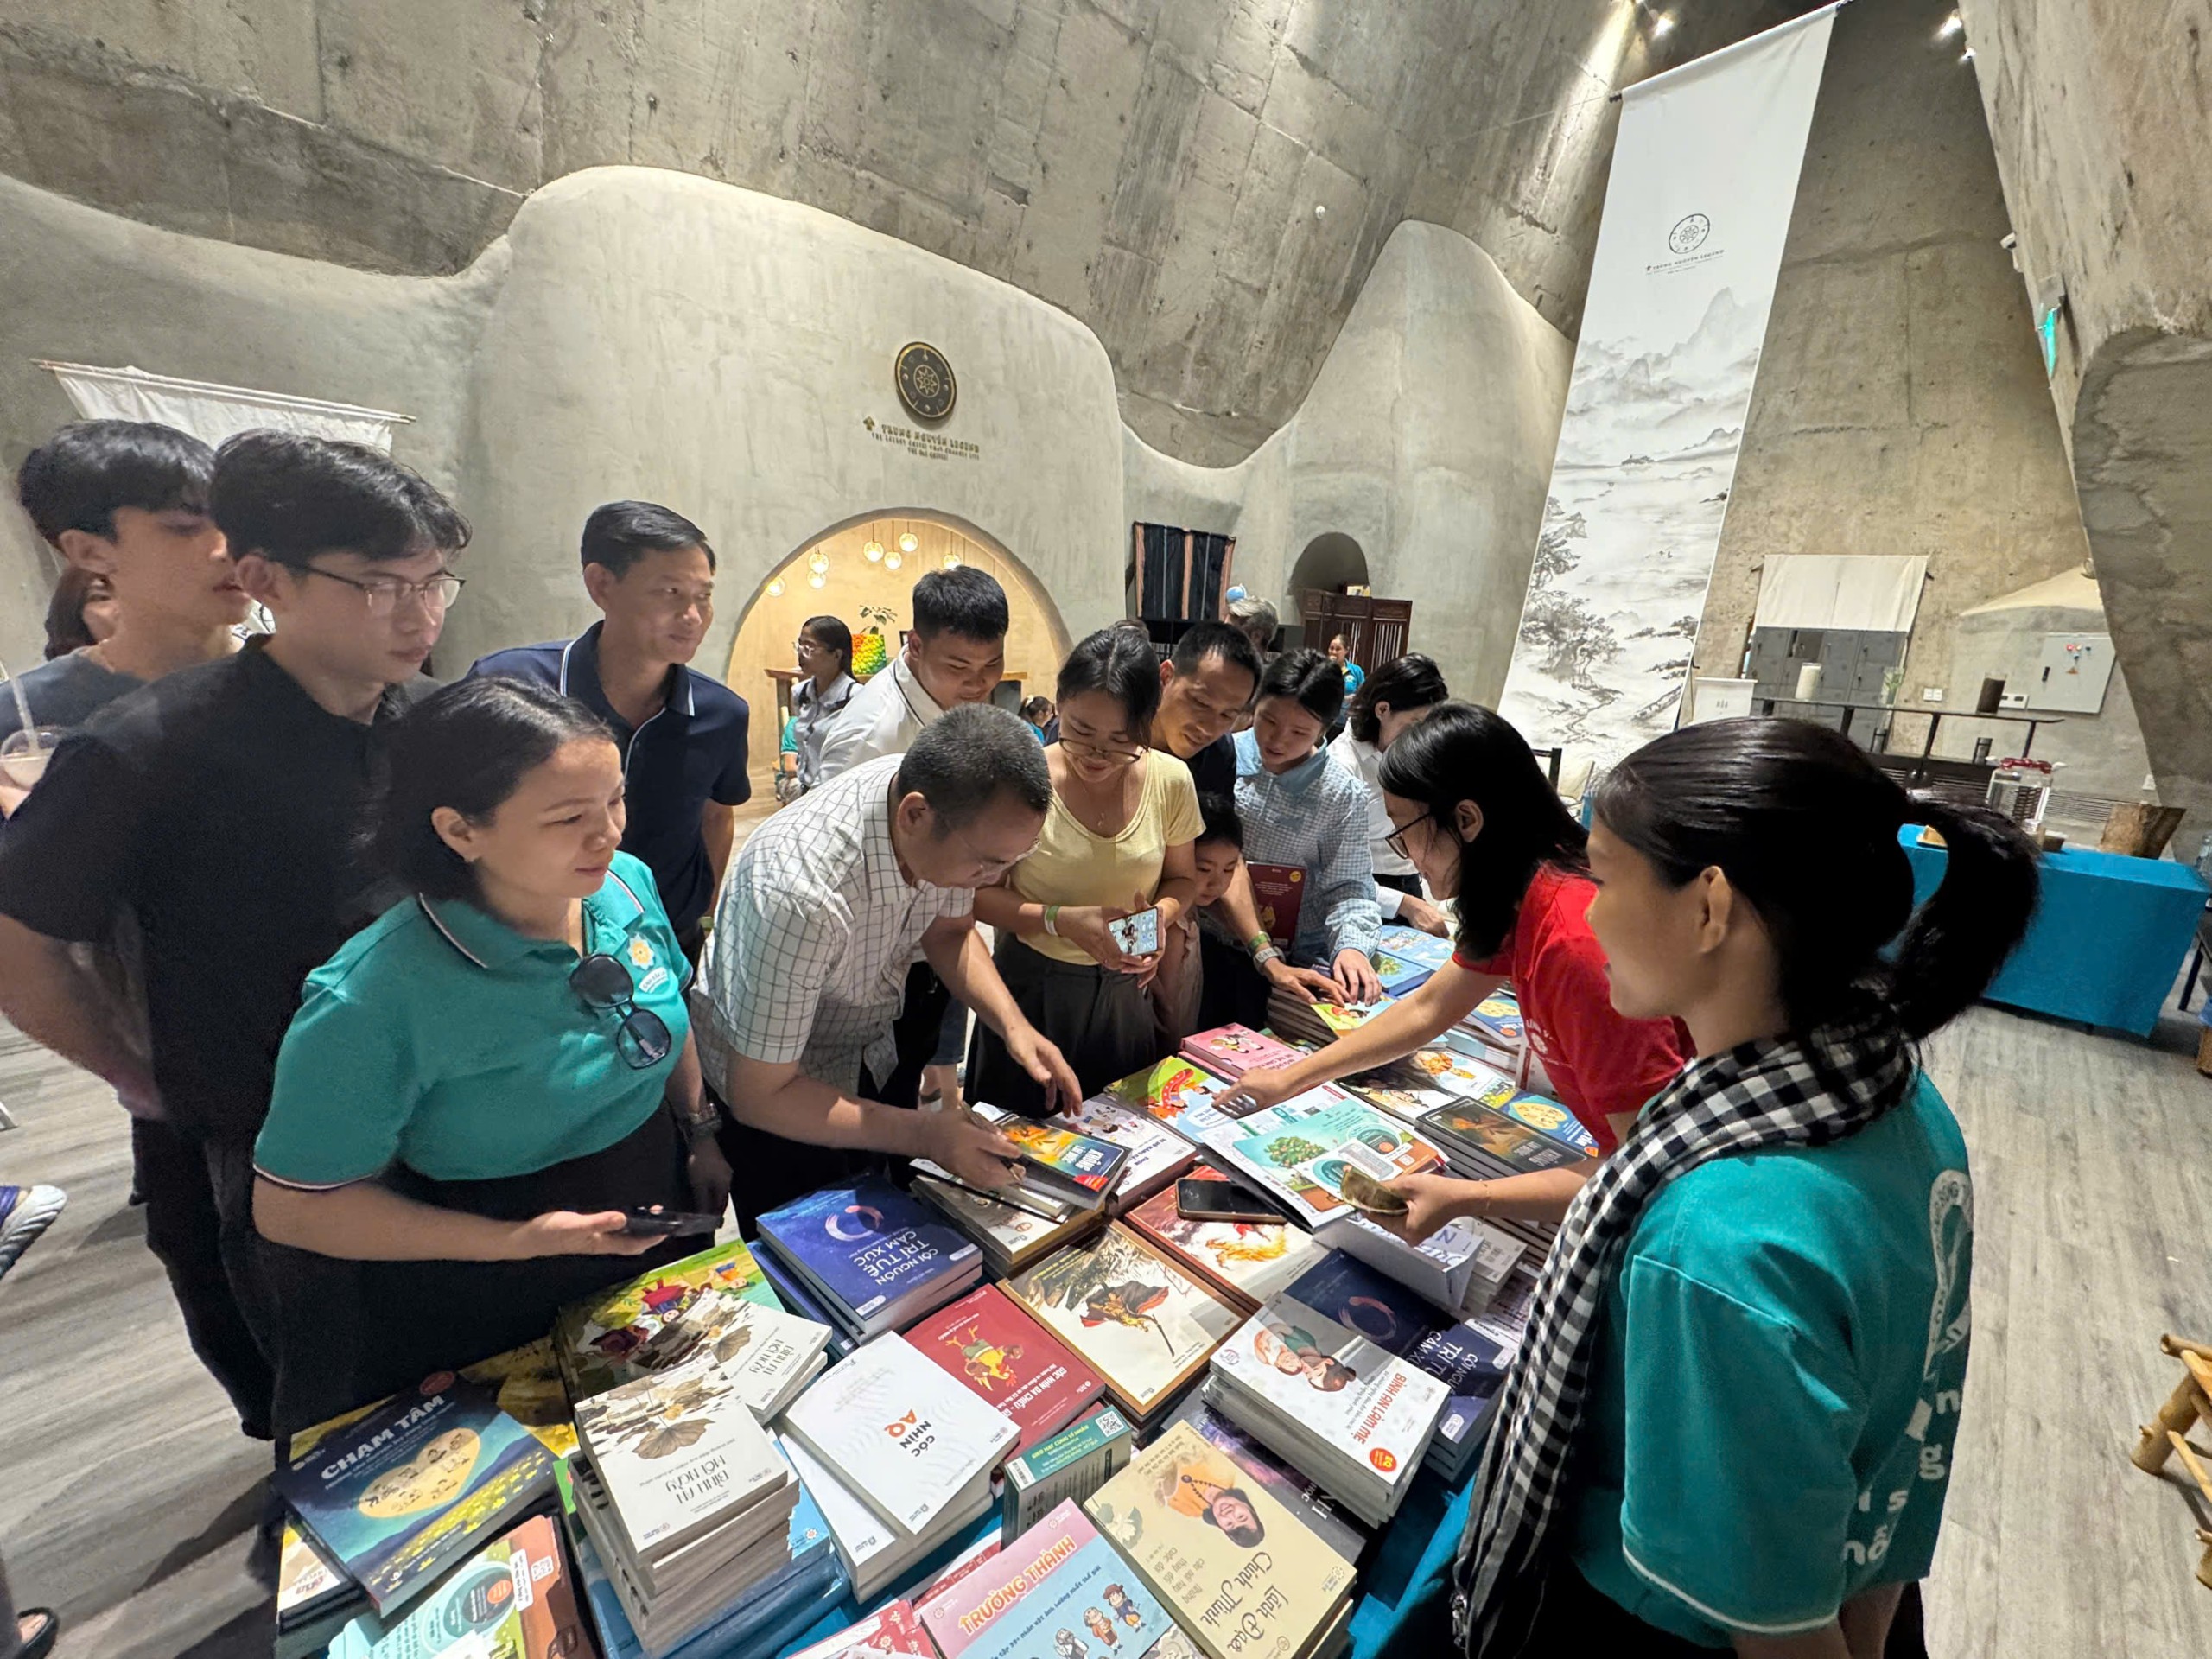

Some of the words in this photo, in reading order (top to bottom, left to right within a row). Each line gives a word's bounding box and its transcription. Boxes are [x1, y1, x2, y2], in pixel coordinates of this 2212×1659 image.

[880, 423, 912, 438] TRUNG
[949, 438, 980, 453] LEGEND
[884, 1230, 917, 1250] CẢM
[899, 1239, 930, 1260] TRÍ
[917, 1246, 938, 1262] CỘI
[852, 1245, 886, 1268] XÚC
[861, 1253, 901, 1278] TUỆ
[874, 1257, 918, 1287] NGUỒN
[1416, 1327, 1446, 1358] CẢM
[1435, 1337, 1465, 1367] TRÍ
[1051, 1364, 1068, 1382] GÓC
[1457, 1349, 1480, 1372] CỘI
[1029, 1384, 1042, 1396] ĐA
[1037, 1374, 1056, 1392] NHÌN
[1384, 1371, 1410, 1399] BÌNH
[1012, 1390, 1034, 1412] CHIỀU
[1376, 1392, 1394, 1410] AN
[882, 1406, 920, 1442] AQ
[1362, 1404, 1389, 1432] LÀM
[319, 1427, 395, 1481] CHẠM
[393, 1394, 445, 1428] TÂM
[898, 1419, 931, 1450] NHÌN
[908, 1432, 938, 1459] GÓC
[1031, 1449, 1044, 1459] GIEO
[1052, 1433, 1069, 1447] CÙNG
[1072, 1421, 1090, 1436] NHÂN
[1349, 1421, 1372, 1445] MẸ
[699, 1453, 727, 1477] MỖI
[1382, 1454, 1393, 1469] EQ
[663, 1465, 701, 1496] NGÀY
[674, 1485, 696, 1504] AN
[695, 1468, 732, 1497] BÌNH
[1230, 1548, 1277, 1593] Chính
[955, 1572, 1029, 1637] TRƯỞNG
[1021, 1533, 1078, 1582] THÀNH
[1191, 1578, 1247, 1633] Mình
[1254, 1584, 1290, 1621] Lãnh
[1217, 1609, 1268, 1659] Đạo
